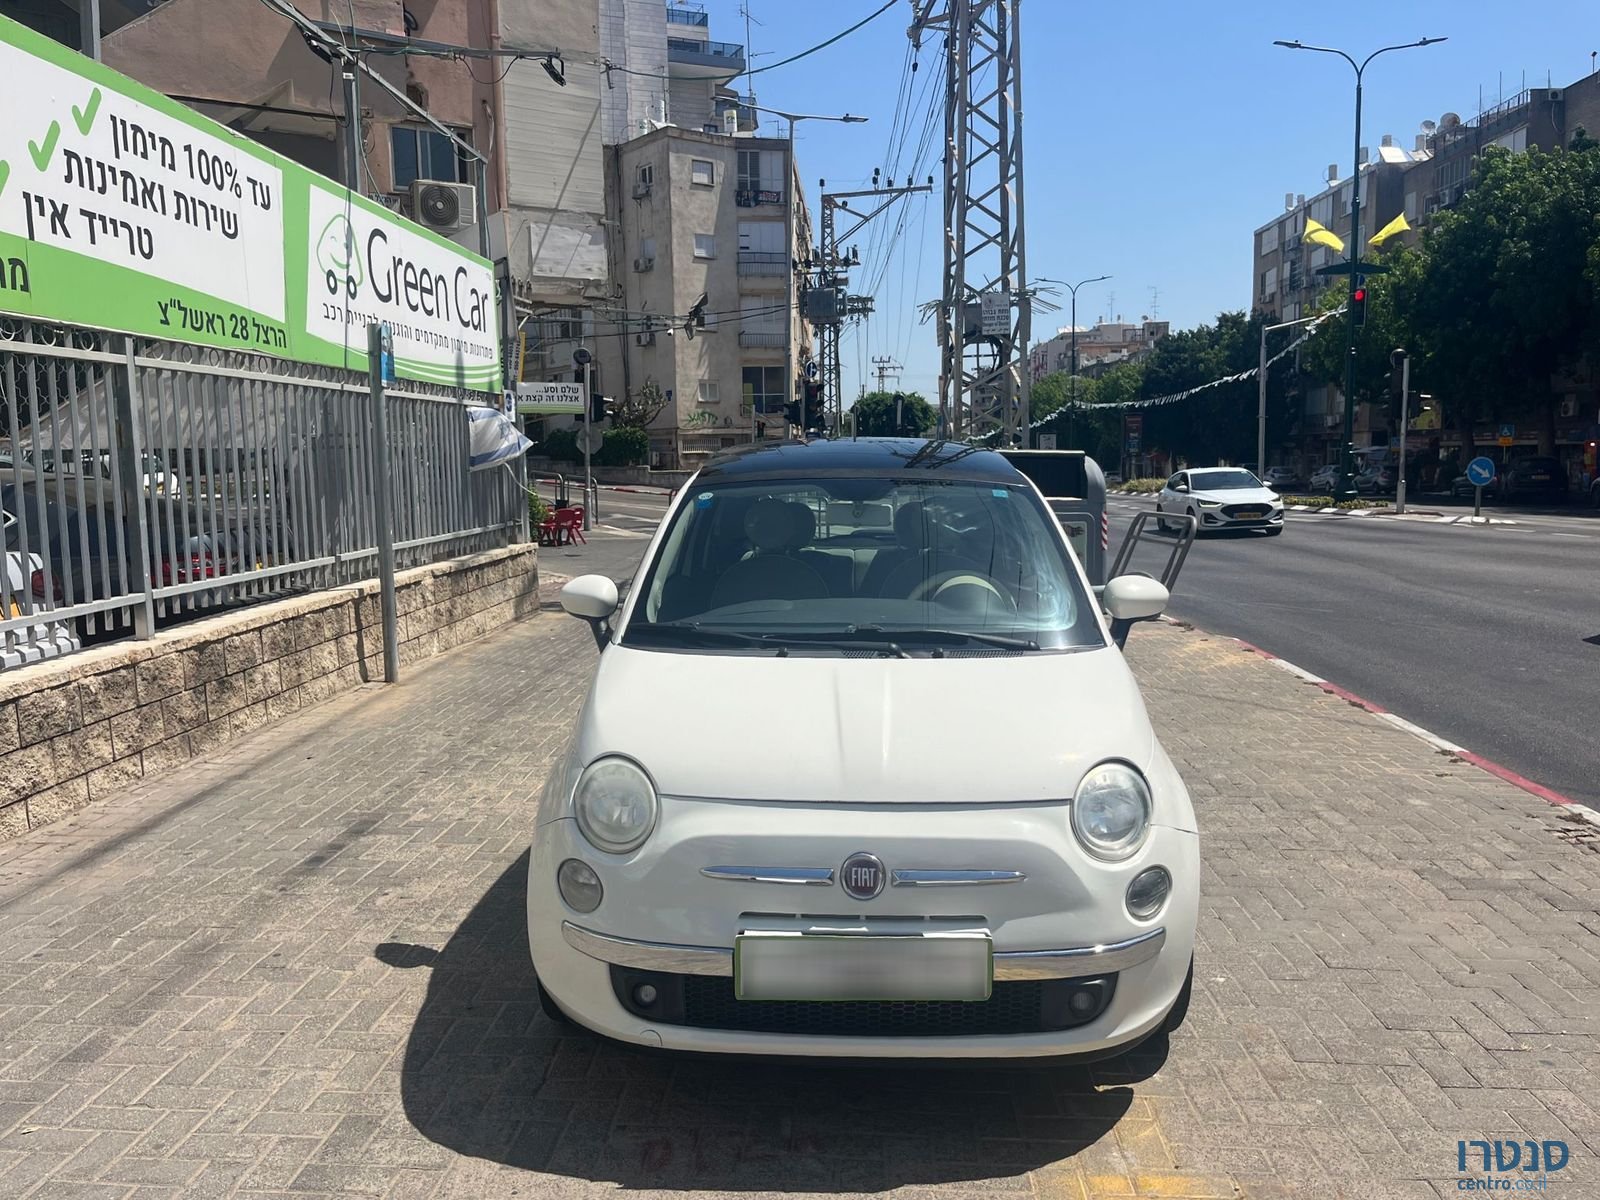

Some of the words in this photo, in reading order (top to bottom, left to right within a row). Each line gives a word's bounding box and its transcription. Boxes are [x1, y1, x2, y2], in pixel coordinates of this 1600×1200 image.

[110, 113, 176, 172] מימון
[63, 148, 167, 216] ואמינות
[183, 143, 242, 199] 100%
[247, 175, 271, 210] עד
[22, 190, 71, 241] אין
[174, 190, 239, 239] שירות
[79, 207, 154, 260] טרייד
[367, 228, 450, 322] Green
[454, 266, 488, 333] Car
[229, 313, 249, 341] 28
[322, 302, 343, 323] רכב
[252, 317, 287, 349] הרצל
[415, 328, 449, 349] מתקדמים
[451, 337, 468, 353] מימון
[525, 394, 543, 404] קצת
[535, 386, 558, 394] וסע...
[557, 393, 579, 402] אצלנו
[561, 385, 579, 394] שלם
[852, 867, 876, 887] FIAT
